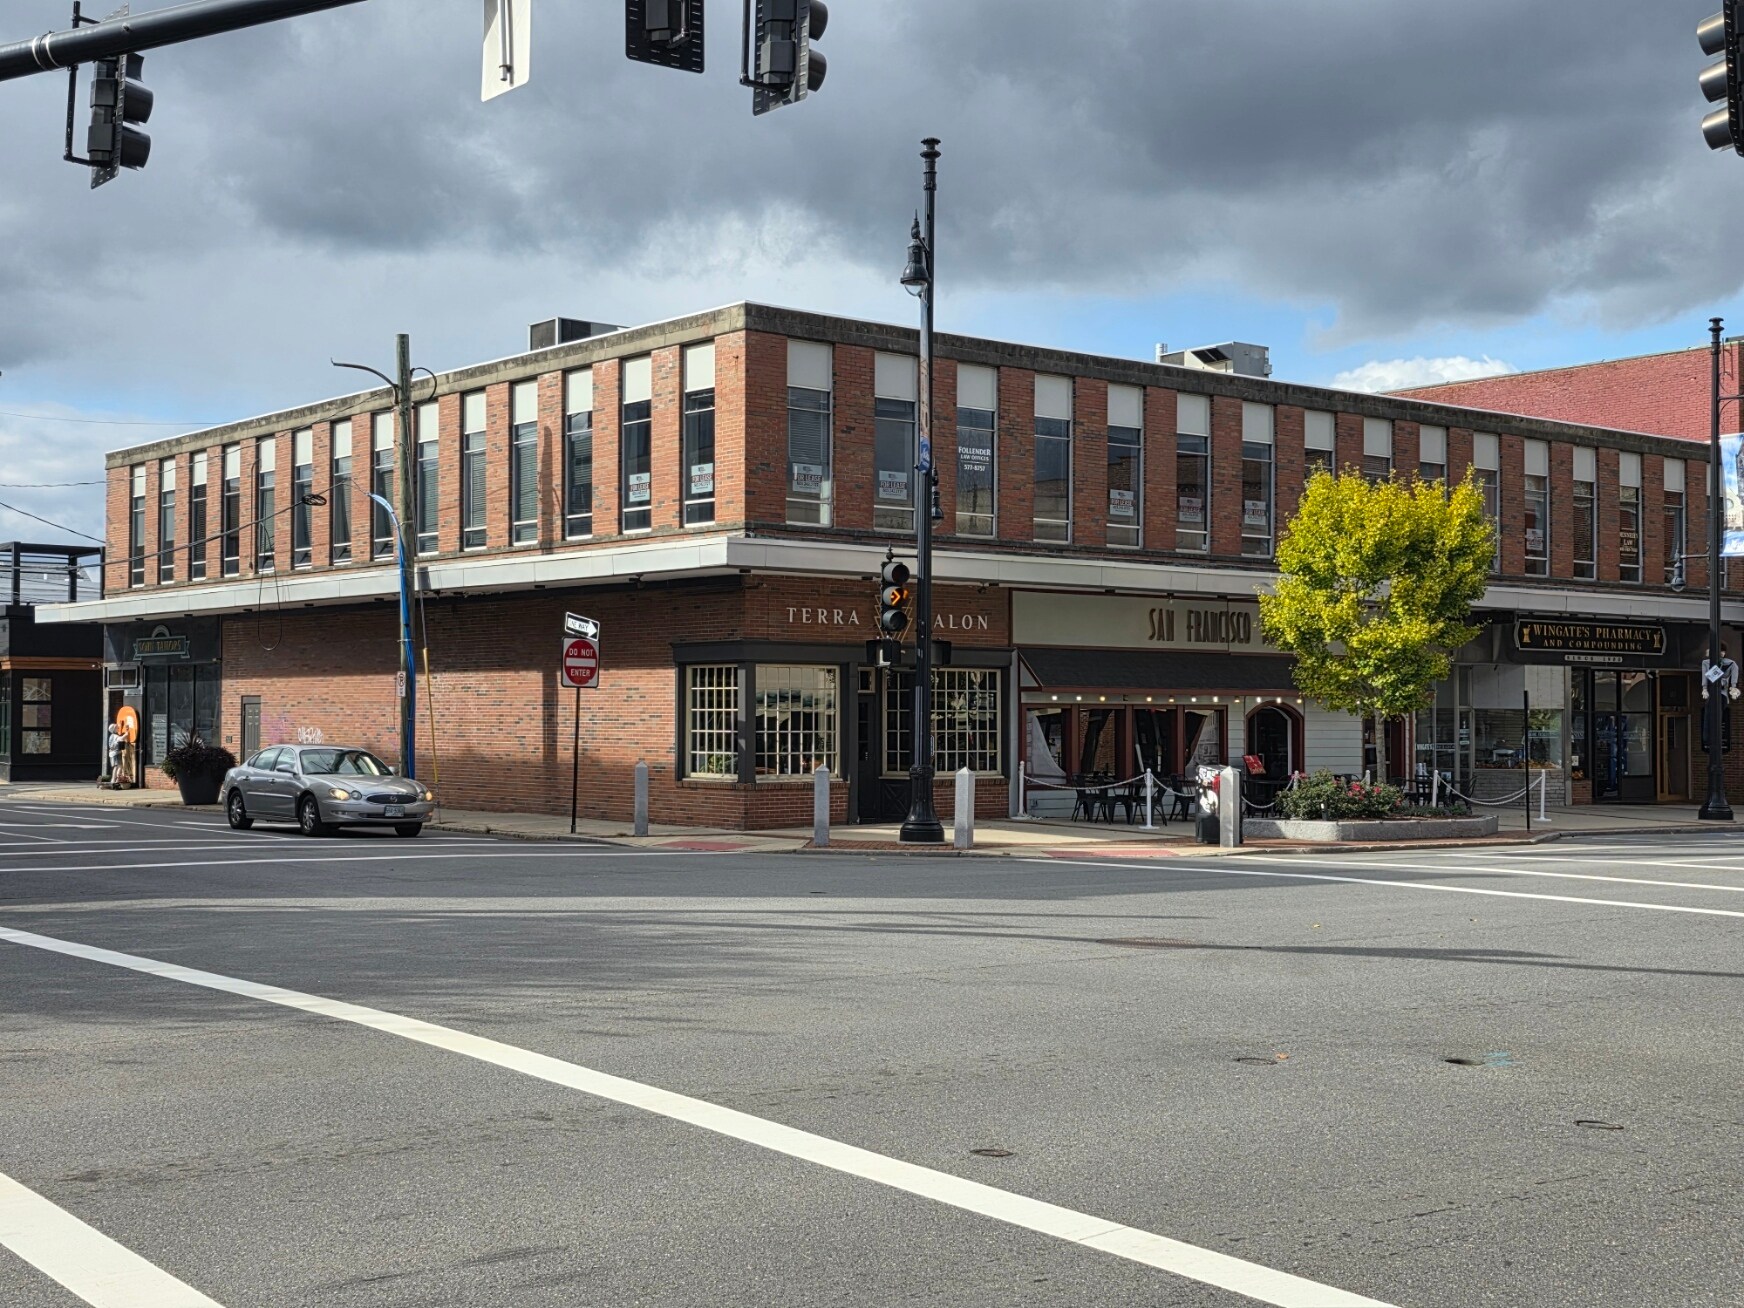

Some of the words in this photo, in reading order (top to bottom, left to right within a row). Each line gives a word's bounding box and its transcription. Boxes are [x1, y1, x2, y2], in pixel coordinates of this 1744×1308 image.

[958, 446, 991, 456] FOLLENDER
[786, 607, 860, 625] TERRA
[933, 613, 988, 630] ALON
[578, 623, 588, 631] WAY
[1148, 608, 1174, 641] SAN
[1187, 609, 1251, 644] FRANCISCO
[1533, 624, 1590, 638] WINGATE'S
[1596, 627, 1652, 641] PHARMACY
[1543, 639, 1563, 647] AND
[1569, 640, 1642, 650] COMPOUNDING
[569, 648, 578, 656] DO
[581, 649, 593, 657] NOT
[570, 668, 591, 676] ENTER
